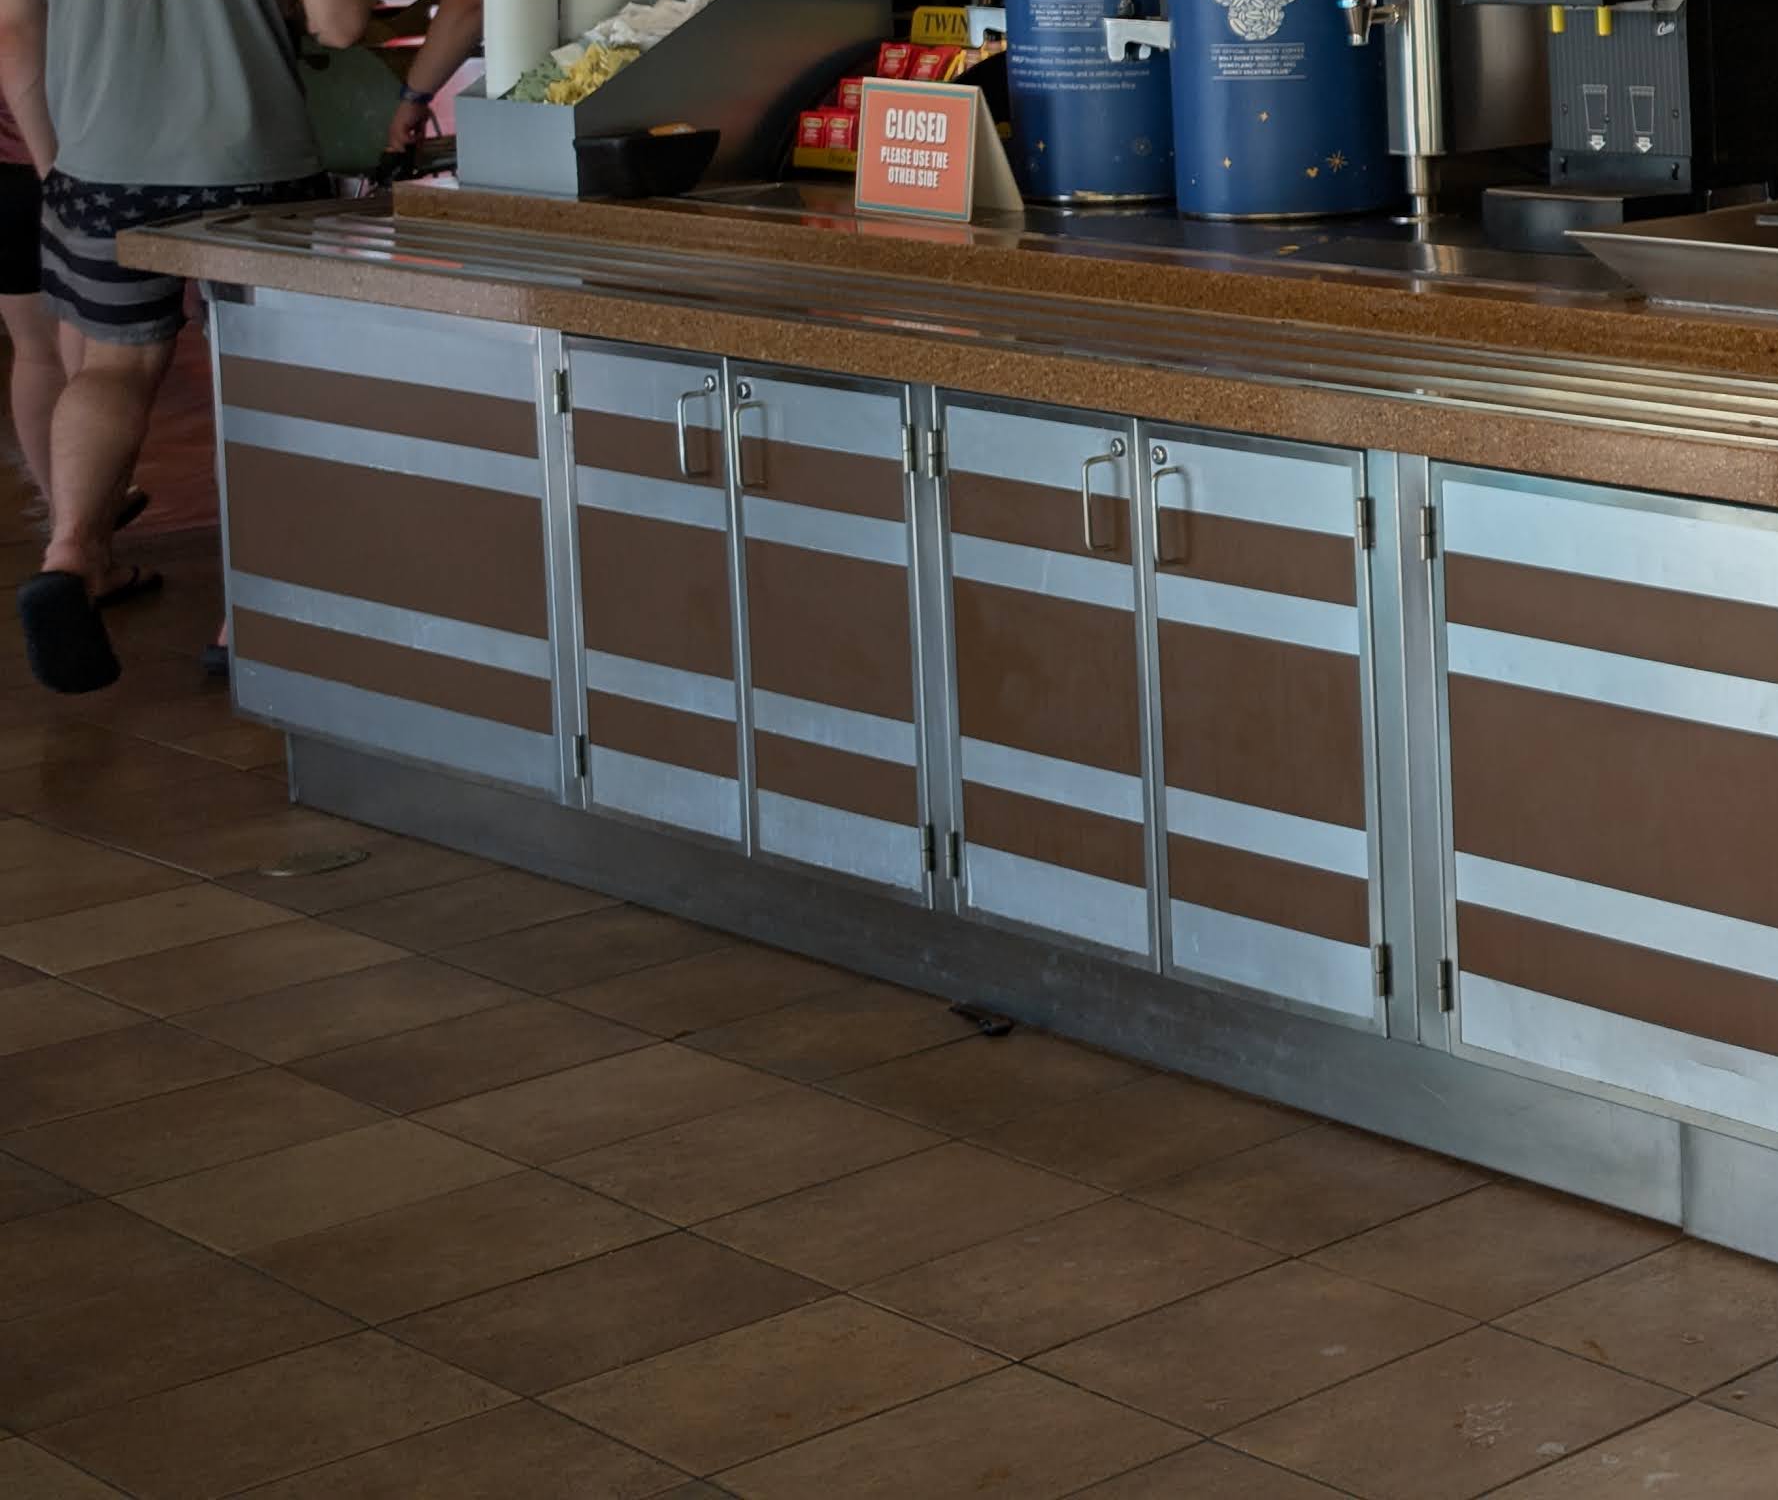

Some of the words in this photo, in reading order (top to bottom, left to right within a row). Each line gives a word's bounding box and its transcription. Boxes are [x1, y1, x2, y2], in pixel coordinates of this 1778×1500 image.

[922, 13, 968, 35] TWIN
[885, 108, 948, 144] CLOSED
[880, 146, 912, 165] PLEASE
[913, 149, 932, 168] USE
[932, 151, 950, 170] THE
[887, 167, 918, 186] OTHER
[918, 170, 940, 189] SIDE
